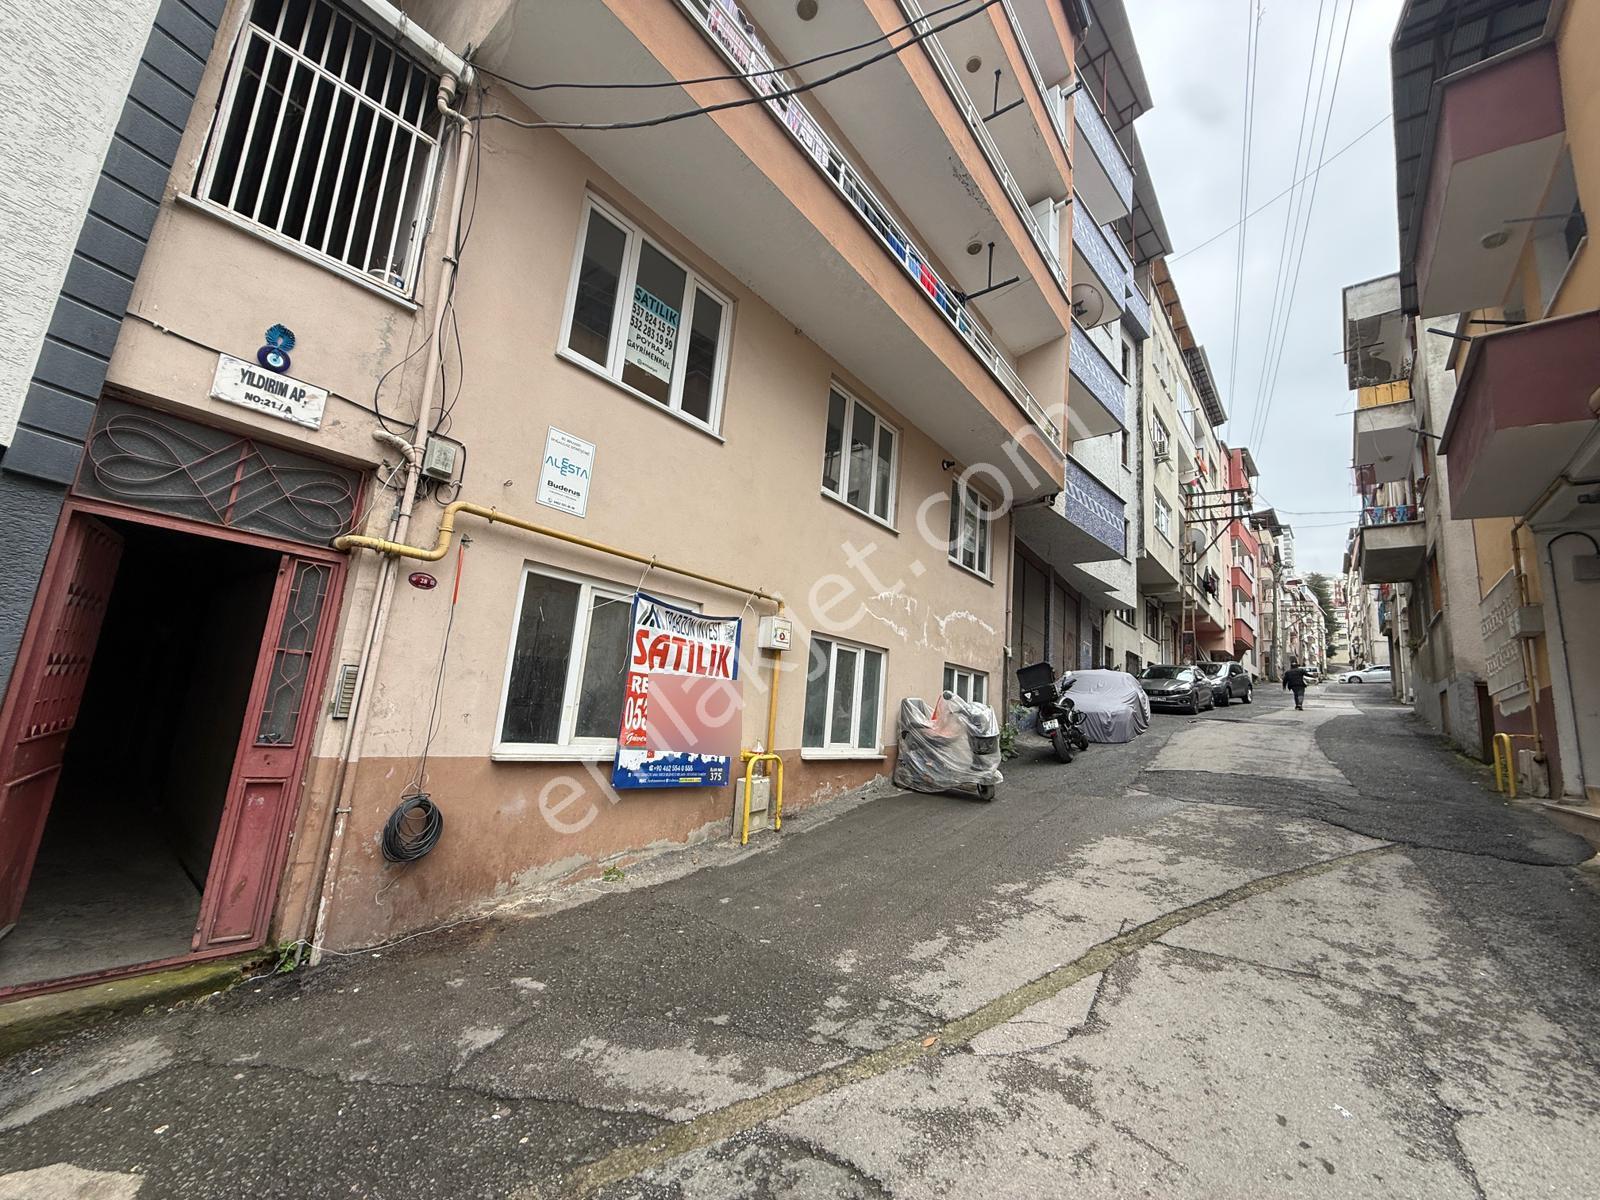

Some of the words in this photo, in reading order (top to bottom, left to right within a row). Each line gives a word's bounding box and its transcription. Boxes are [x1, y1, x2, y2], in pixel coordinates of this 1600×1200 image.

[632, 303, 644, 317] 537
[644, 311, 657, 327] 824
[657, 320, 666, 333] 15
[666, 325, 675, 338] 97
[634, 288, 677, 324] SATILIK
[630, 316, 642, 332] 532
[642, 324, 655, 340] 283
[655, 332, 664, 345] 19
[664, 337, 673, 351] 99
[636, 333, 666, 356] POYRAZ
[626, 338, 670, 370] GAYRİMENKUL
[240, 368, 289, 399] YILDIRIM
[547, 480, 581, 497] Buderus
[664, 610, 697, 637] TRABZON
[633, 629, 731, 679] SATILIK
[709, 772, 722, 781] 375
